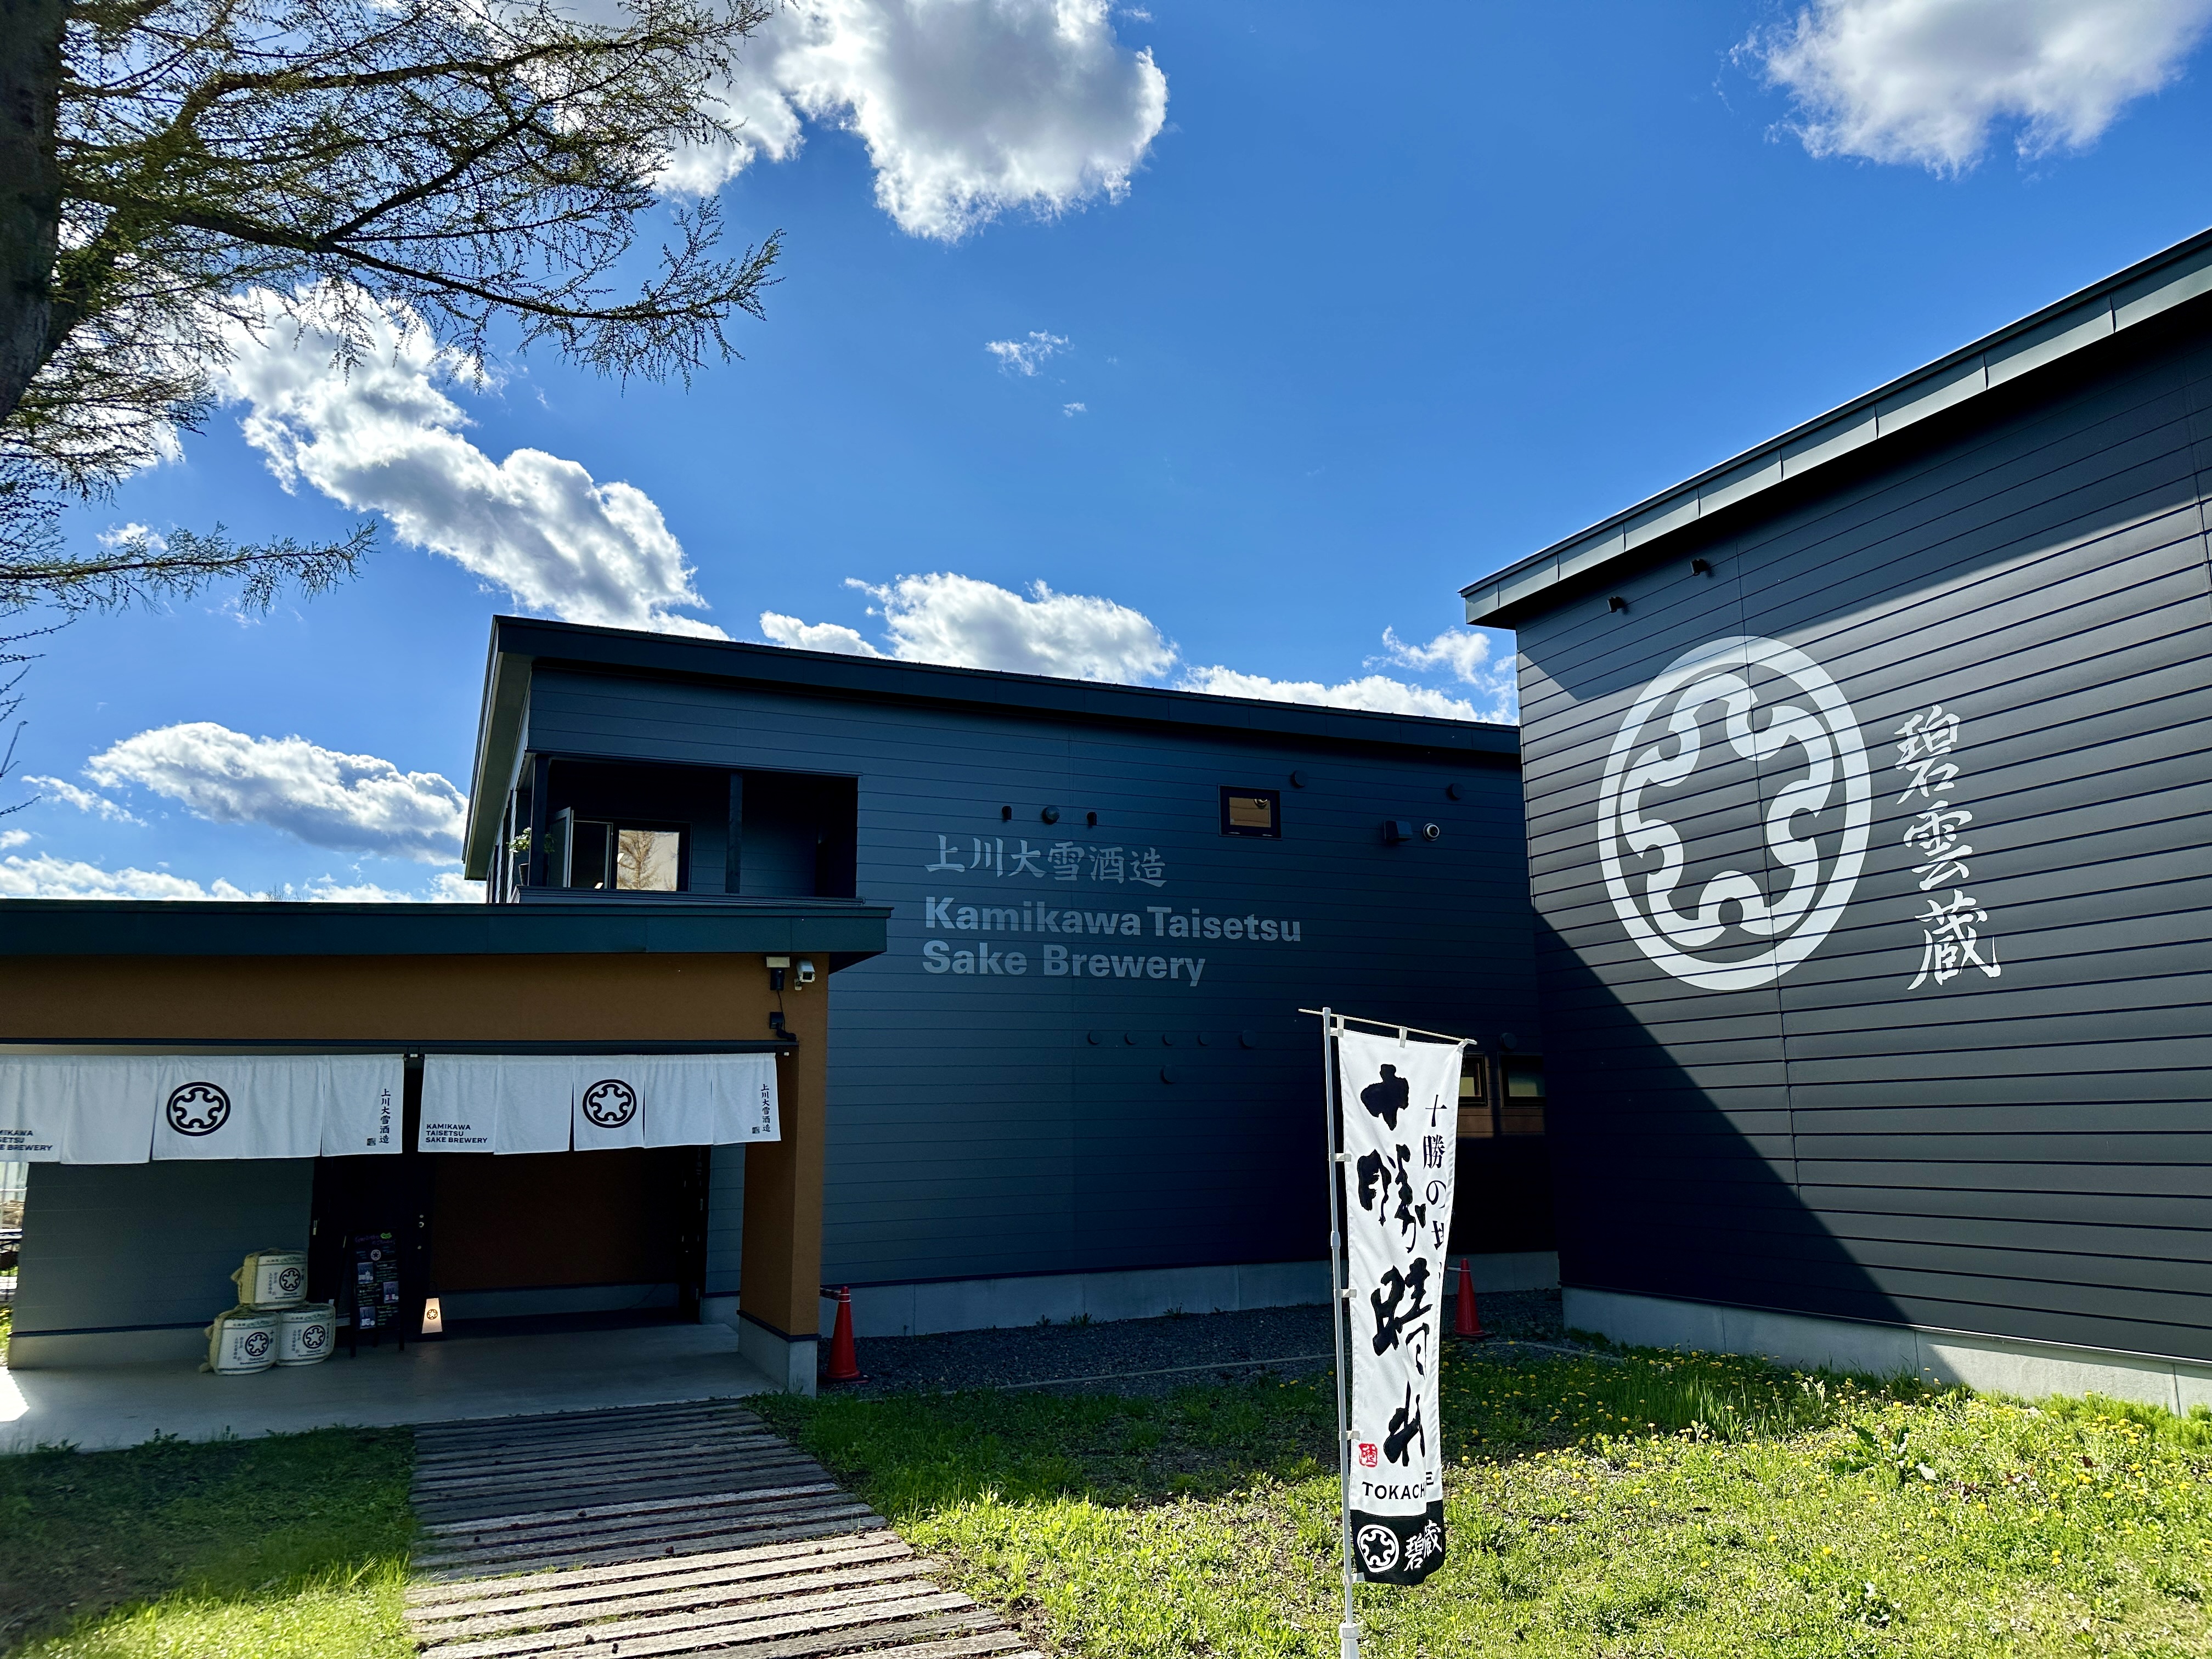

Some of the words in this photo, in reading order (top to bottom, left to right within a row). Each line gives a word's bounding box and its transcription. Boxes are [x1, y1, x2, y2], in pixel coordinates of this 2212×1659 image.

[925, 834, 1167, 887] 上川大雪酒造
[1894, 704, 2002, 990] 碧雲蔵
[926, 896, 1141, 936] Kamikawa
[1147, 906, 1301, 943] Taisetsu
[922, 940, 1028, 975] Sake
[1043, 944, 1206, 986] Brewery
[379, 1088, 391, 1143] 上川大雪酒造
[761, 1084, 771, 1132] 上川大雪酒造
